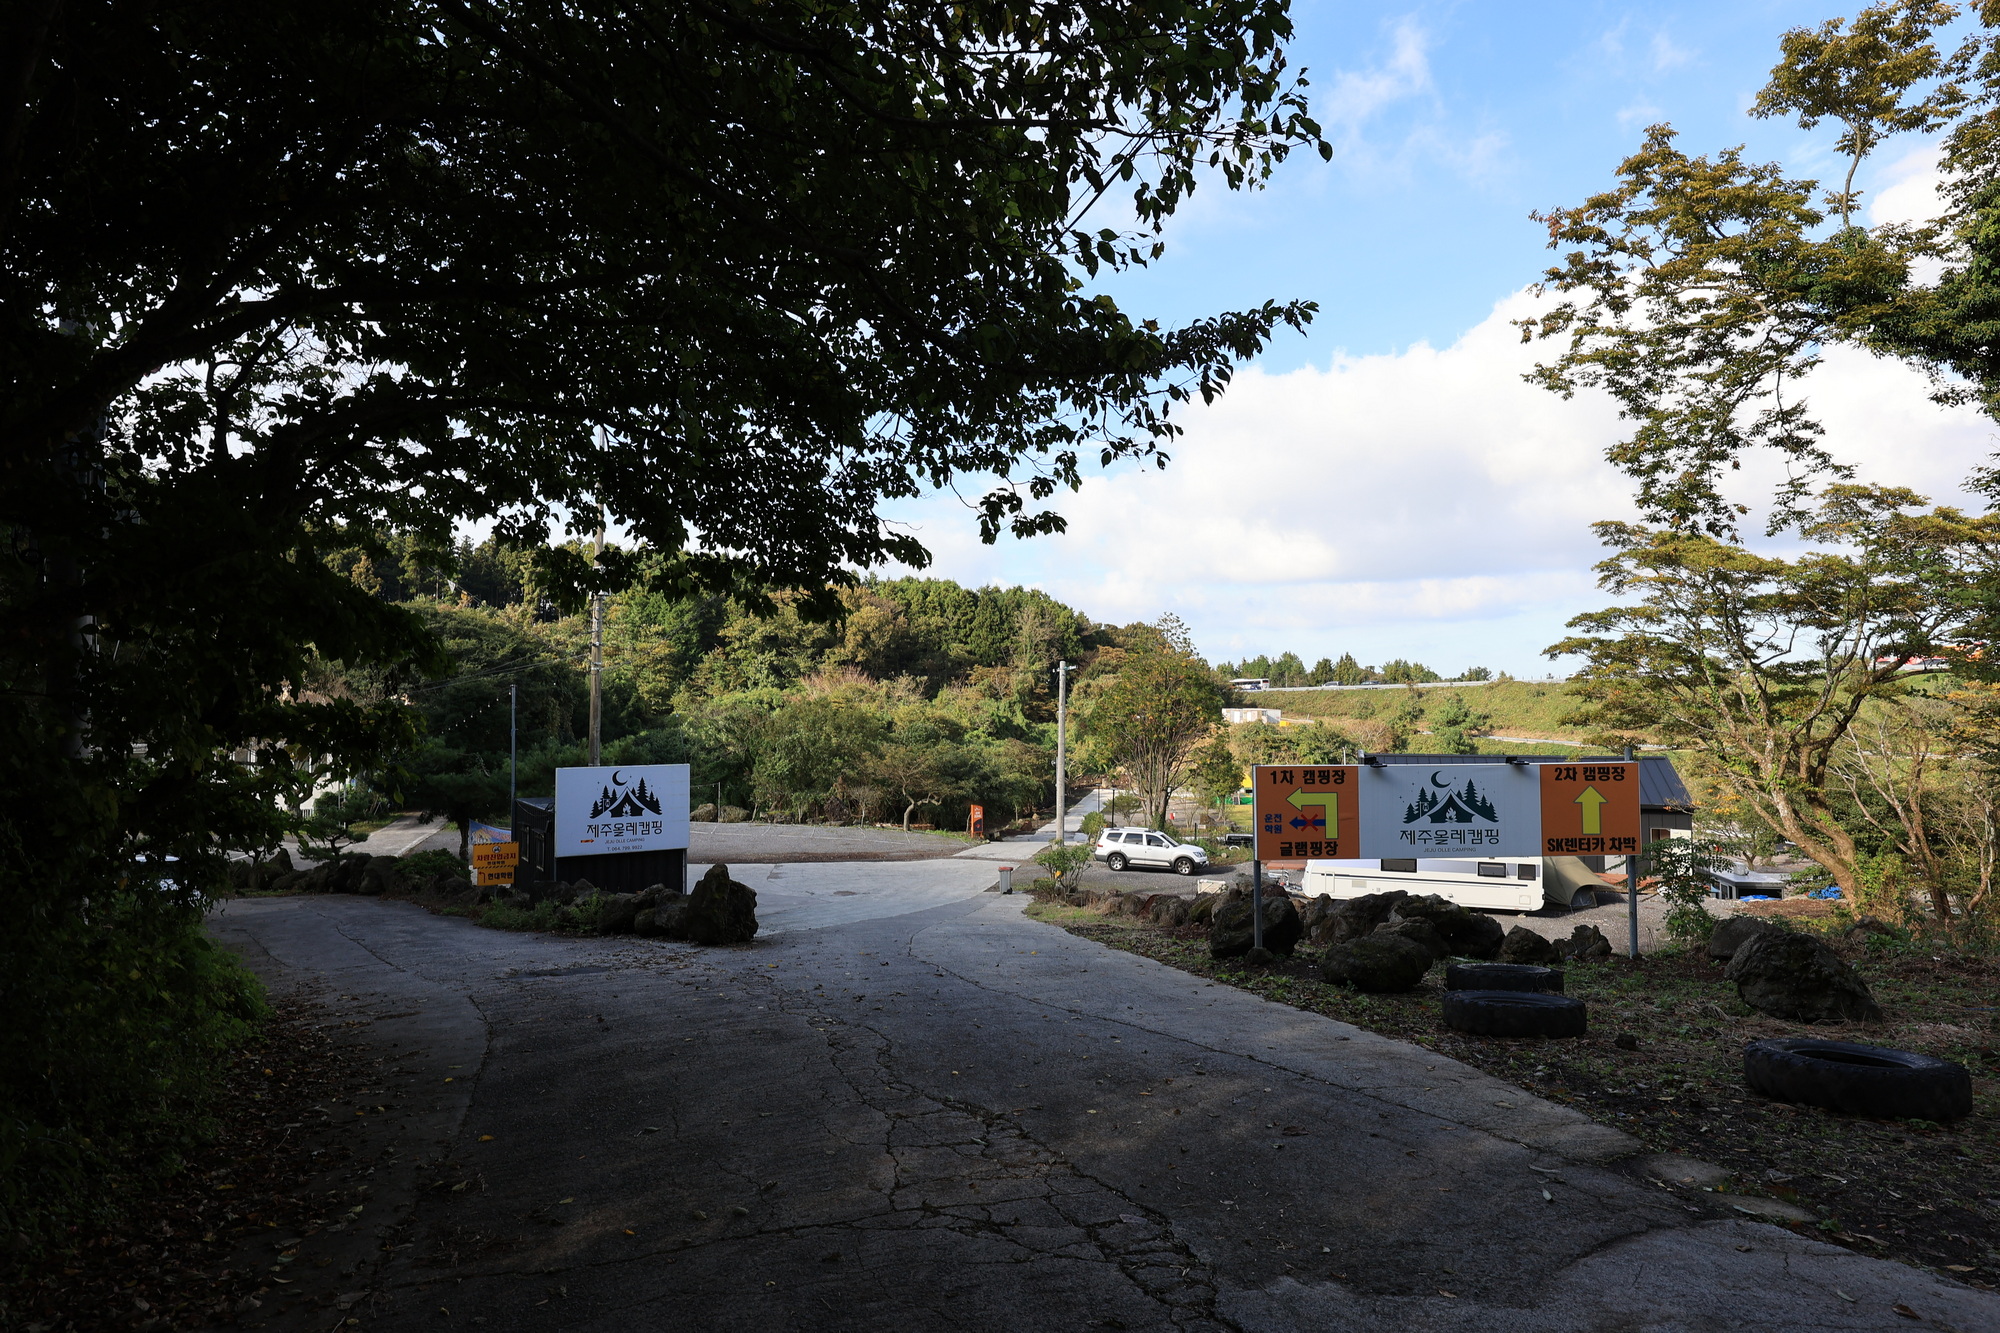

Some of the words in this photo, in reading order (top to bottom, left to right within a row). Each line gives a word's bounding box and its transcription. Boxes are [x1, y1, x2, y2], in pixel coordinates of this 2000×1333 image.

[1270, 770, 1294, 785] 1차
[1302, 769, 1346, 785] 캠핑장
[1554, 767, 1578, 782] 2차
[1582, 766, 1626, 782] 캠핑장
[1264, 813, 1282, 823] 운전
[586, 820, 663, 838] 제주올레캠핑
[1264, 824, 1282, 834] 학원
[1399, 828, 1500, 845] 제주올레캠핑
[1279, 840, 1338, 856] 글램핑장
[1547, 837, 1606, 852] SK렌터카
[1608, 836, 1637, 852] 차박
[487, 871, 513, 880] 현대학원
